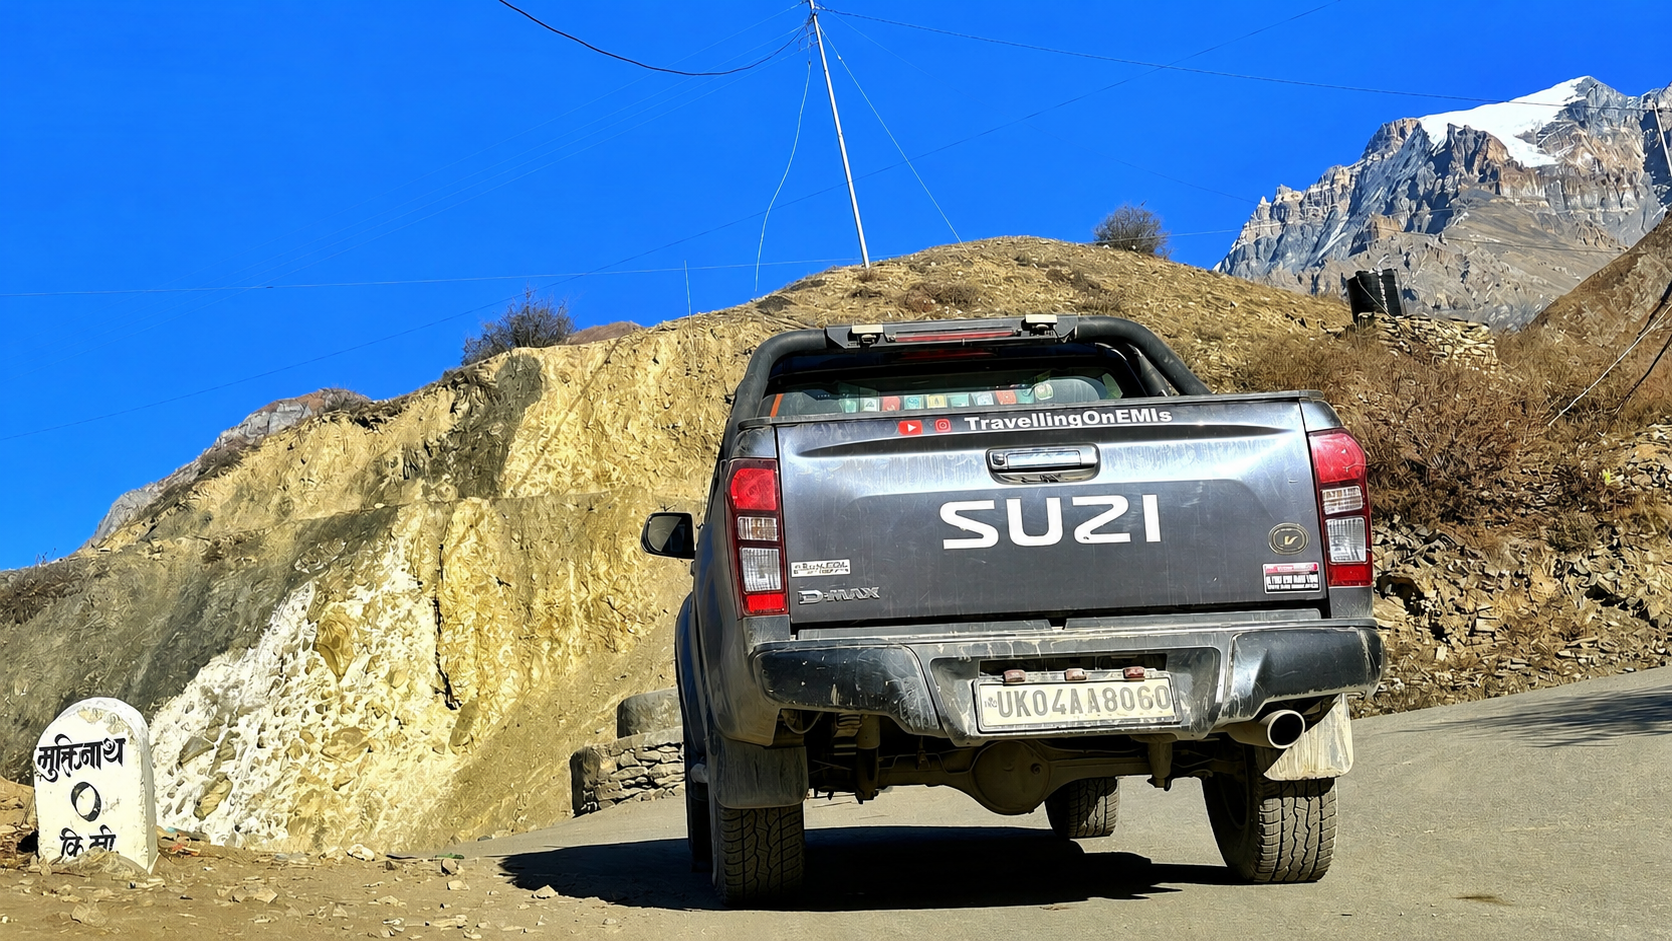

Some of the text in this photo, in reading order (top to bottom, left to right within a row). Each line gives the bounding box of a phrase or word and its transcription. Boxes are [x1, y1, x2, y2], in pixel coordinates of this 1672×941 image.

[964, 408, 1173, 431] TravellingOnEMIs
[940, 494, 1161, 549] SUZI
[798, 587, 880, 605] D-MAX
[997, 685, 1171, 718] UK04AA8060
